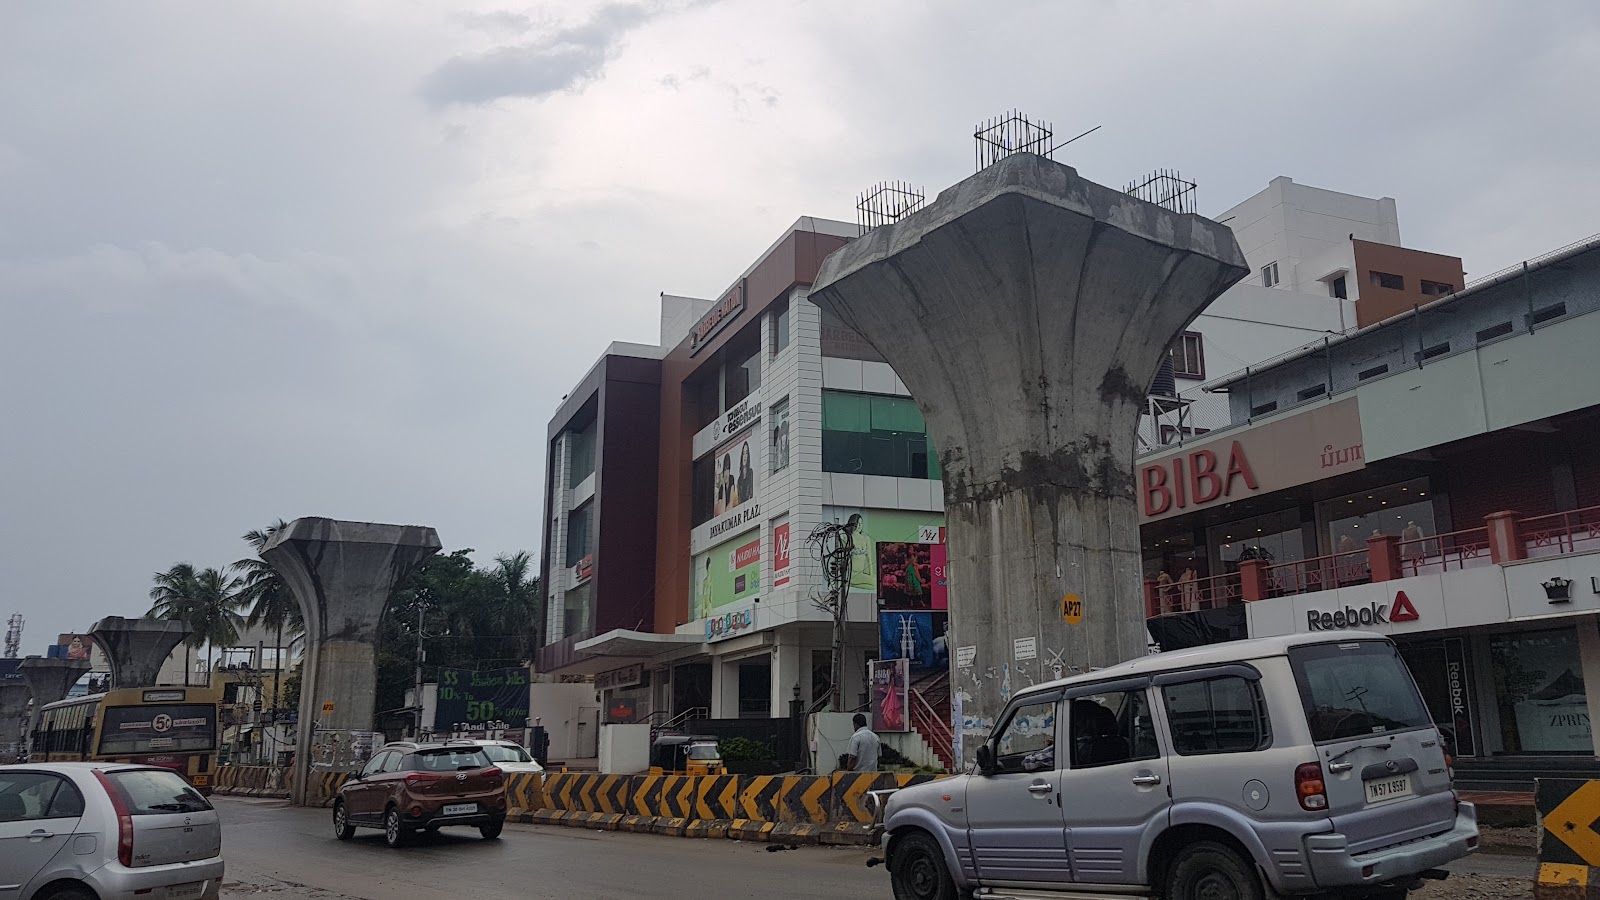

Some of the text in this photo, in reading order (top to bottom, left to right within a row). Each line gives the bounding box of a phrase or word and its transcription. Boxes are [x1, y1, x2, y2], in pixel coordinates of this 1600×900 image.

[1142, 440, 1259, 516] BIBA
[1063, 600, 1081, 617] AP27
[1307, 601, 1389, 631] Reebok
[444, 670, 459, 686] SS
[440, 687, 473, 700] 10% To
[1449, 662, 1464, 714] Reebok
[1370, 779, 1406, 798] TN 57 X 9597
